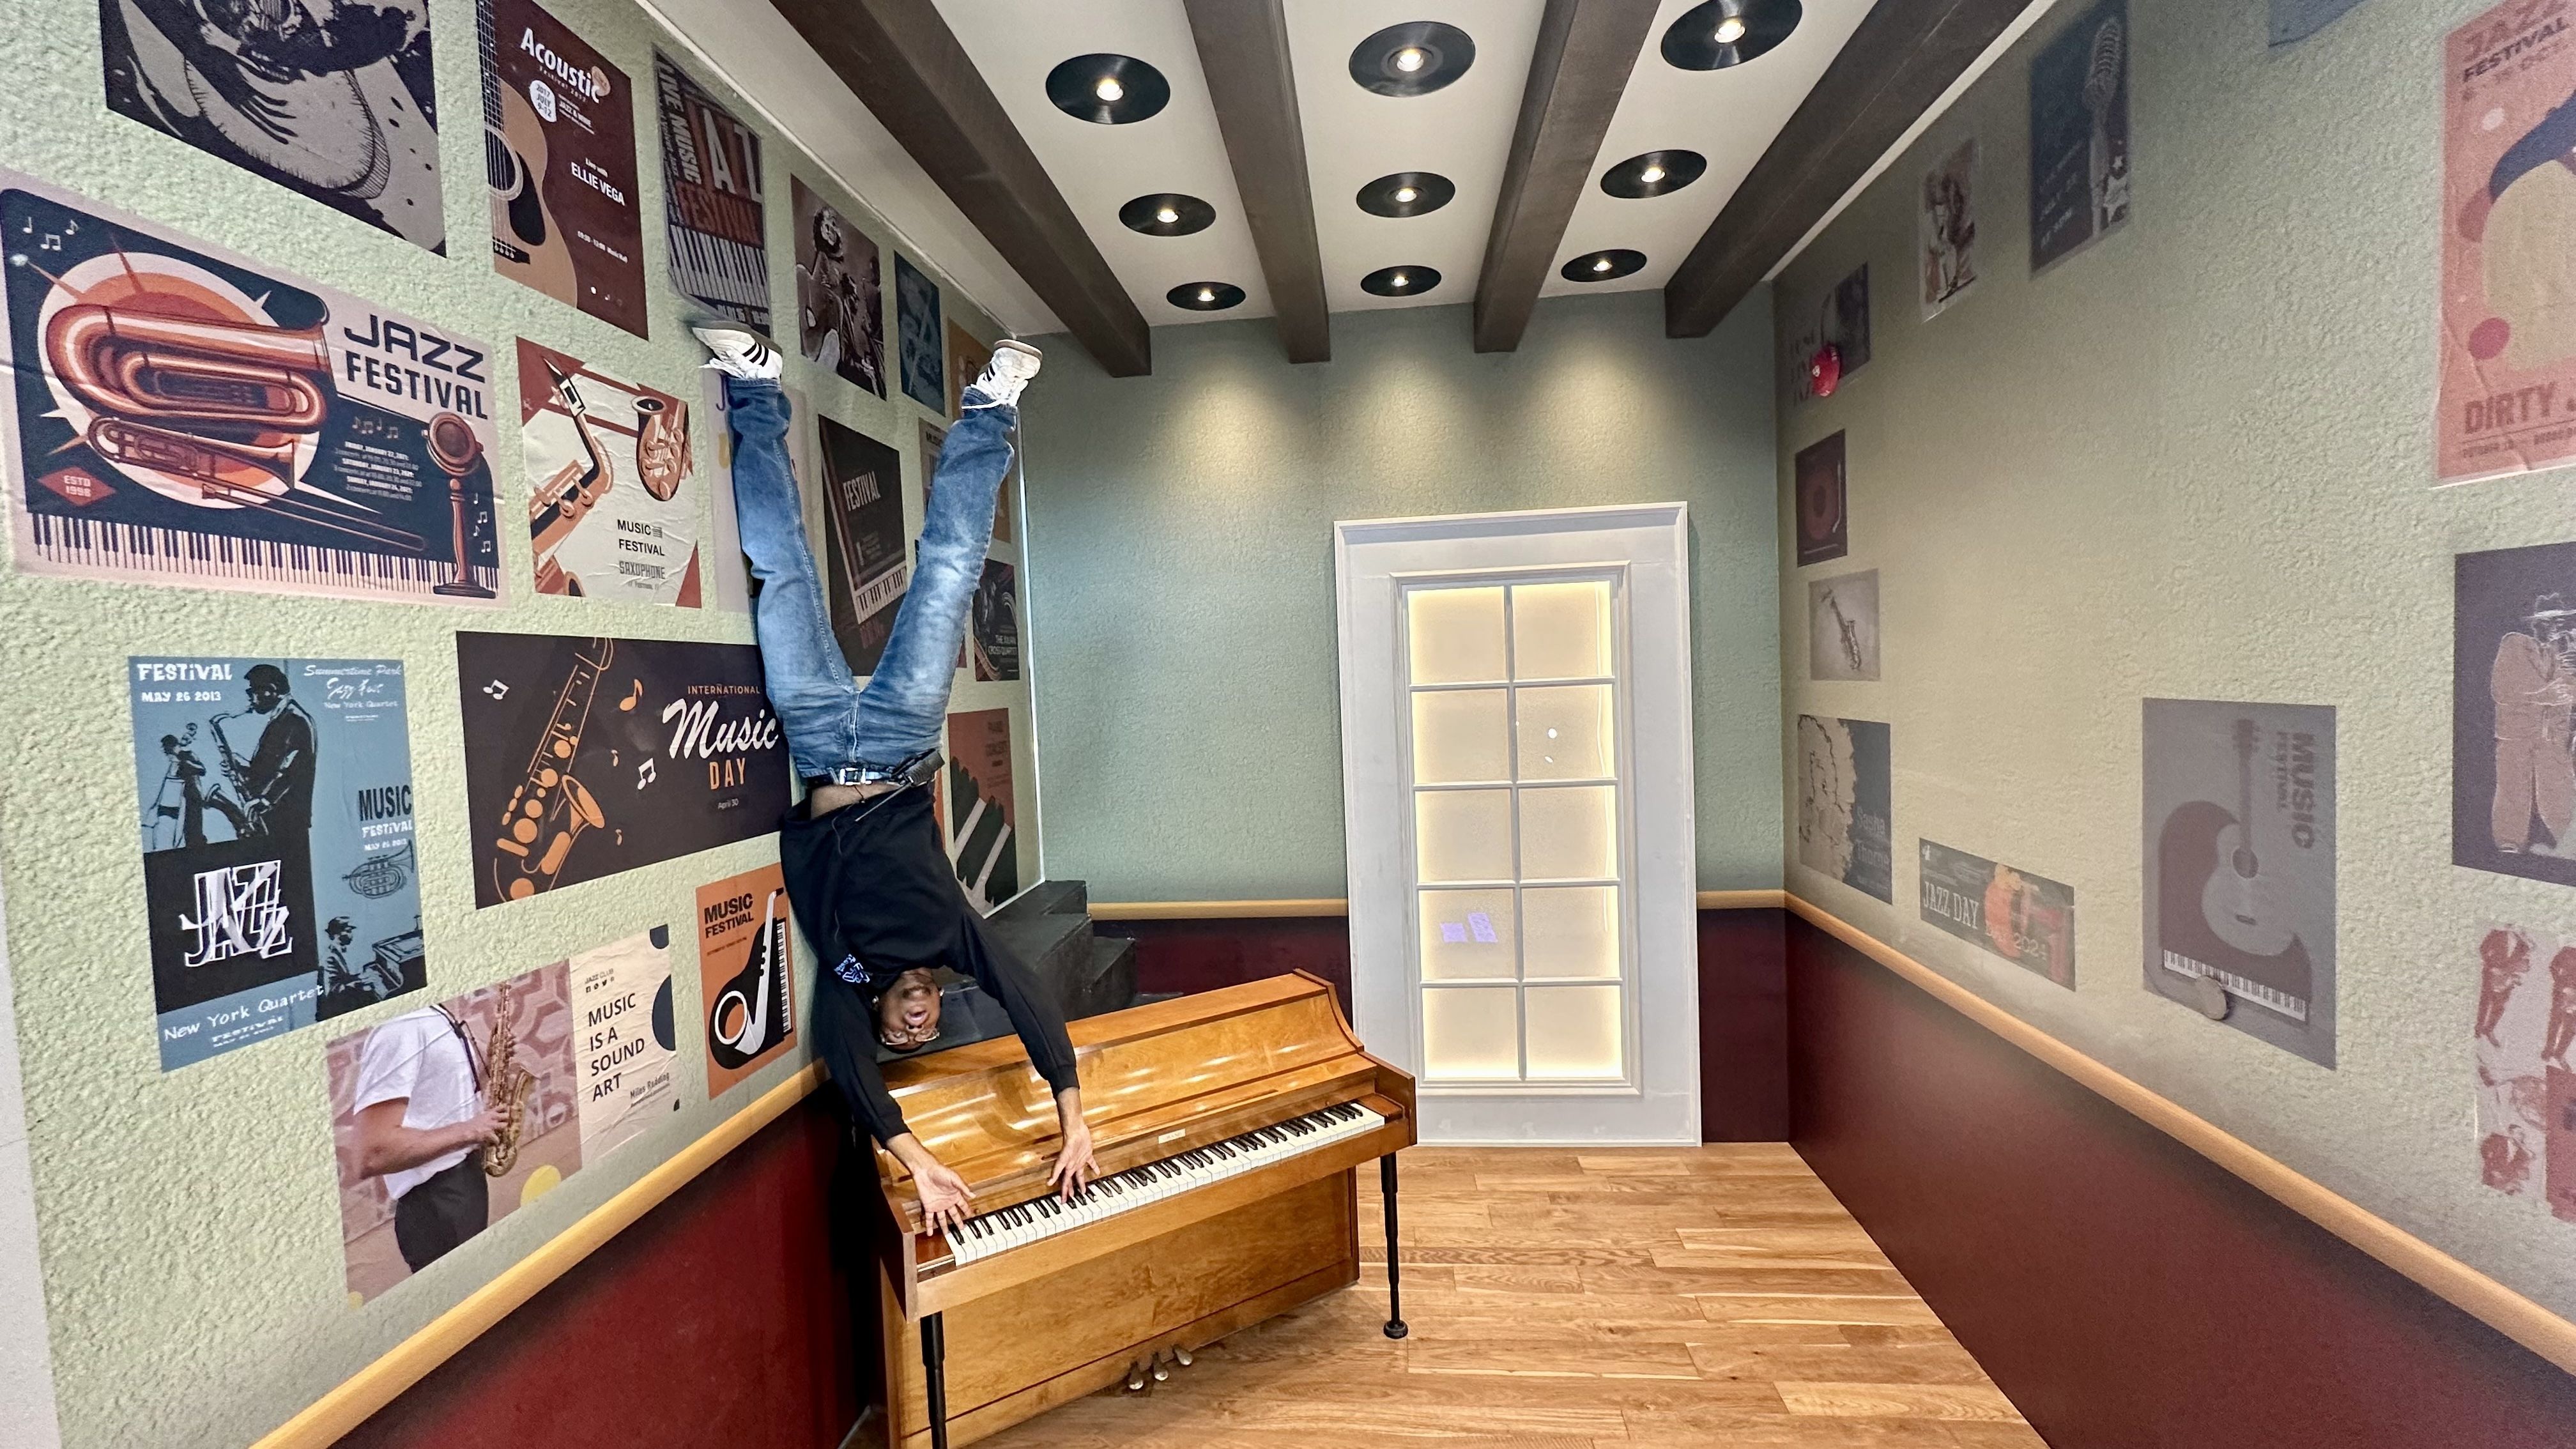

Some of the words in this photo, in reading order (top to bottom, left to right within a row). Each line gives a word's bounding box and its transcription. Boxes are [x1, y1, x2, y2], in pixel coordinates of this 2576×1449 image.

[521, 27, 599, 103] Acoustic
[2464, 17, 2570, 82] FESTIVAL
[537, 95, 551, 107] JULY
[657, 59, 684, 113] LIVE
[669, 112, 702, 185] MUSIC
[571, 161, 599, 190] ELLIE
[599, 179, 625, 206] VEGA
[344, 314, 486, 383] JAZZ
[346, 350, 488, 420] FESTIVAL
[2465, 381, 2555, 434] DIRTY
[63, 475, 91, 487] ESTD
[843, 471, 882, 512] FESTIVAL
[617, 519, 652, 535] MUSIC
[618, 539, 665, 556] FESTIVAL
[619, 561, 666, 579] SAXOPHONE
[303, 665, 372, 677] Summertime
[141, 691, 171, 702] MAY
[176, 691, 191, 702] 26
[194, 691, 222, 702] 2013
[687, 685, 760, 694] INTERNATIONAL
[663, 698, 778, 759] Music
[709, 757, 746, 790] DAY
[358, 785, 412, 822] MUSIC
[717, 801, 732, 809] April
[731, 799, 739, 807] 30
[2291, 732, 2316, 850] MUSIC
[704, 893, 753, 925] MUSIC
[1924, 881, 1950, 917] JAZZ
[1952, 893, 1979, 930] DAY
[705, 911, 755, 939] FESTIVAL
[585, 973, 599, 985] JAZZ
[599, 969, 614, 979] CLUB
[164, 1022, 200, 1041] New
[206, 1005, 250, 1027] York
[258, 985, 324, 1013] Quartet
[588, 993, 636, 1027] MUSIC
[590, 1032, 603, 1052] IS
[608, 1026, 618, 1044] A
[591, 1038, 645, 1077] SOUND
[592, 1072, 622, 1102] ART
